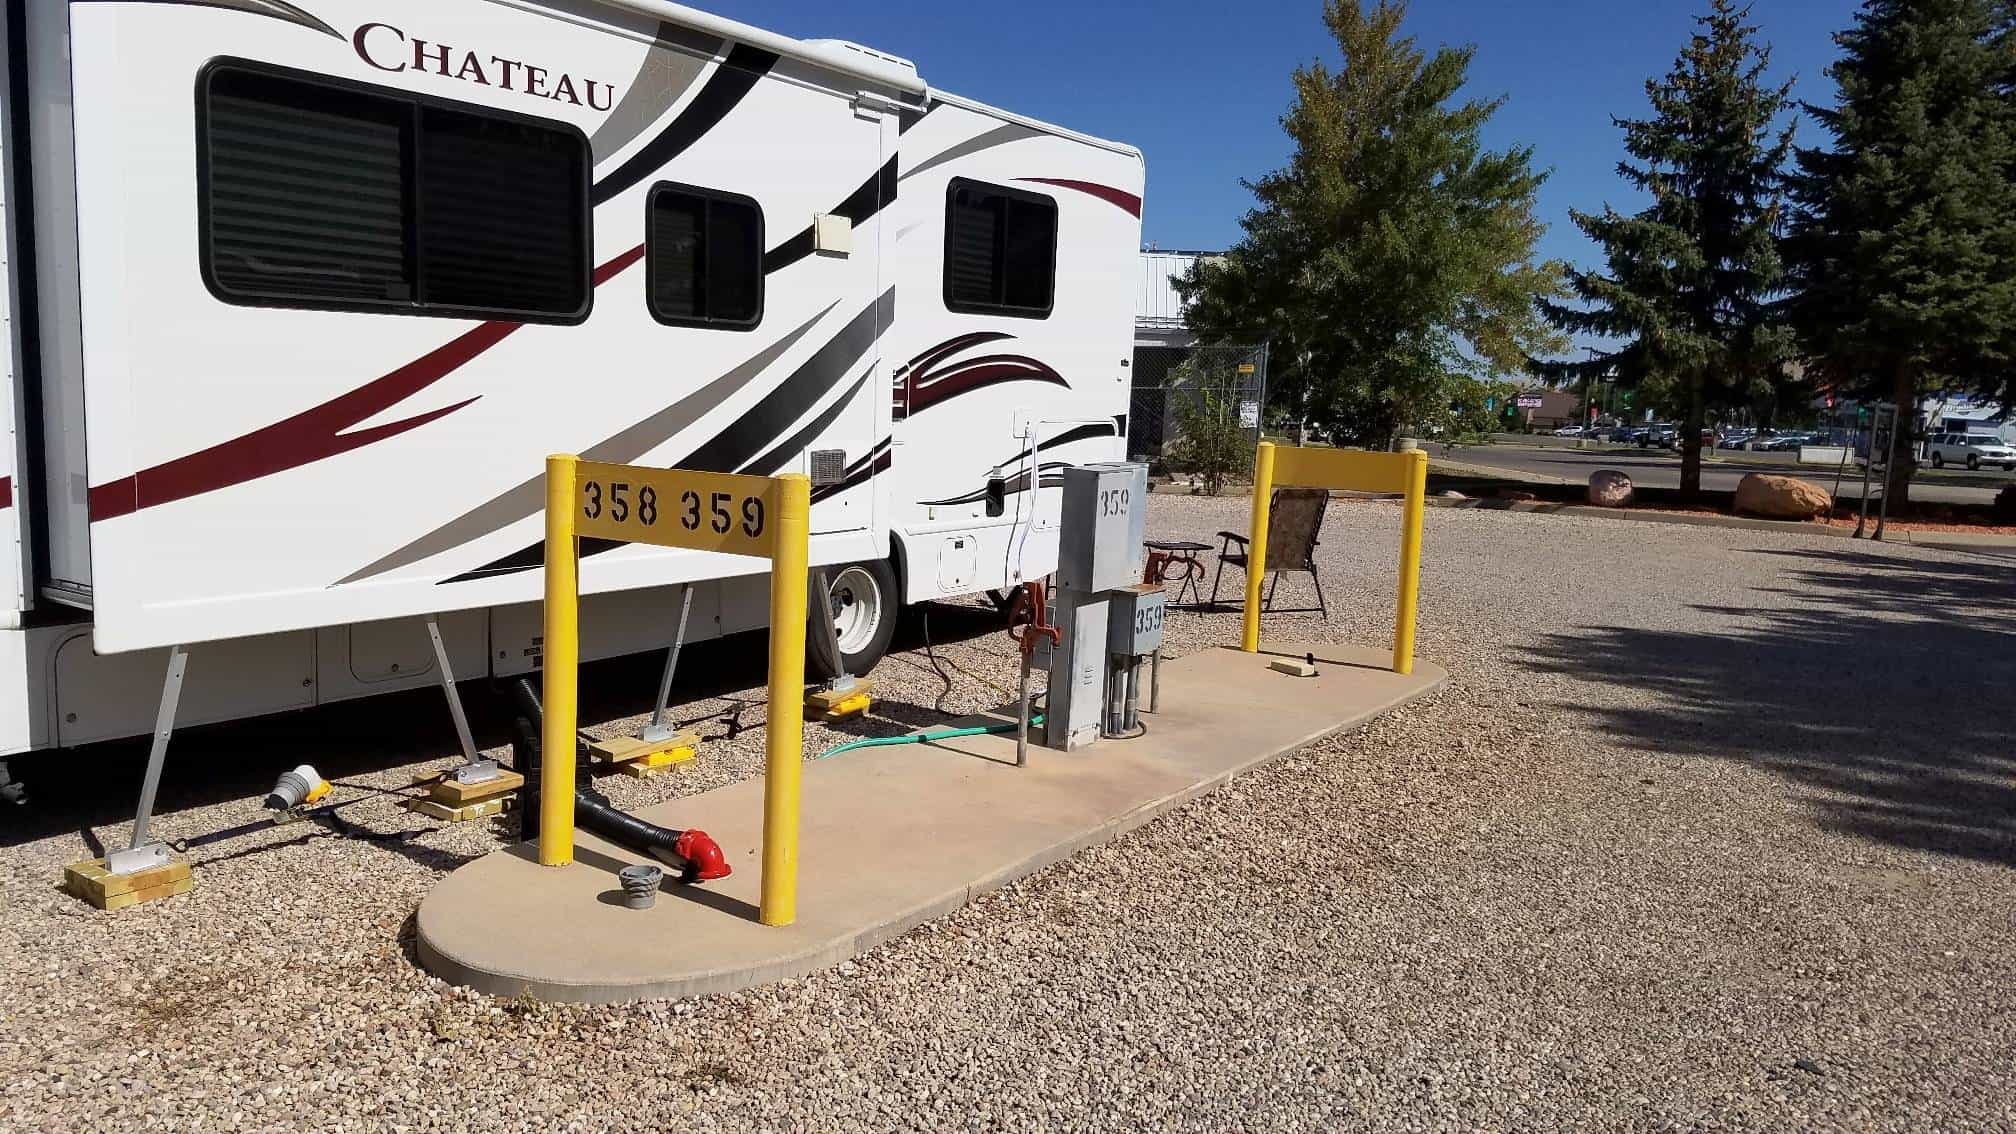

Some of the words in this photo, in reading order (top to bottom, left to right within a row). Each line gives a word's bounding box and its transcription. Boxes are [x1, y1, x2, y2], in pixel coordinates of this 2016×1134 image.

[353, 23, 615, 111] CHATEAU
[584, 481, 657, 526] 358
[681, 490, 765, 538] 359
[1101, 488, 1129, 517] 359
[1136, 604, 1162, 634] 359
